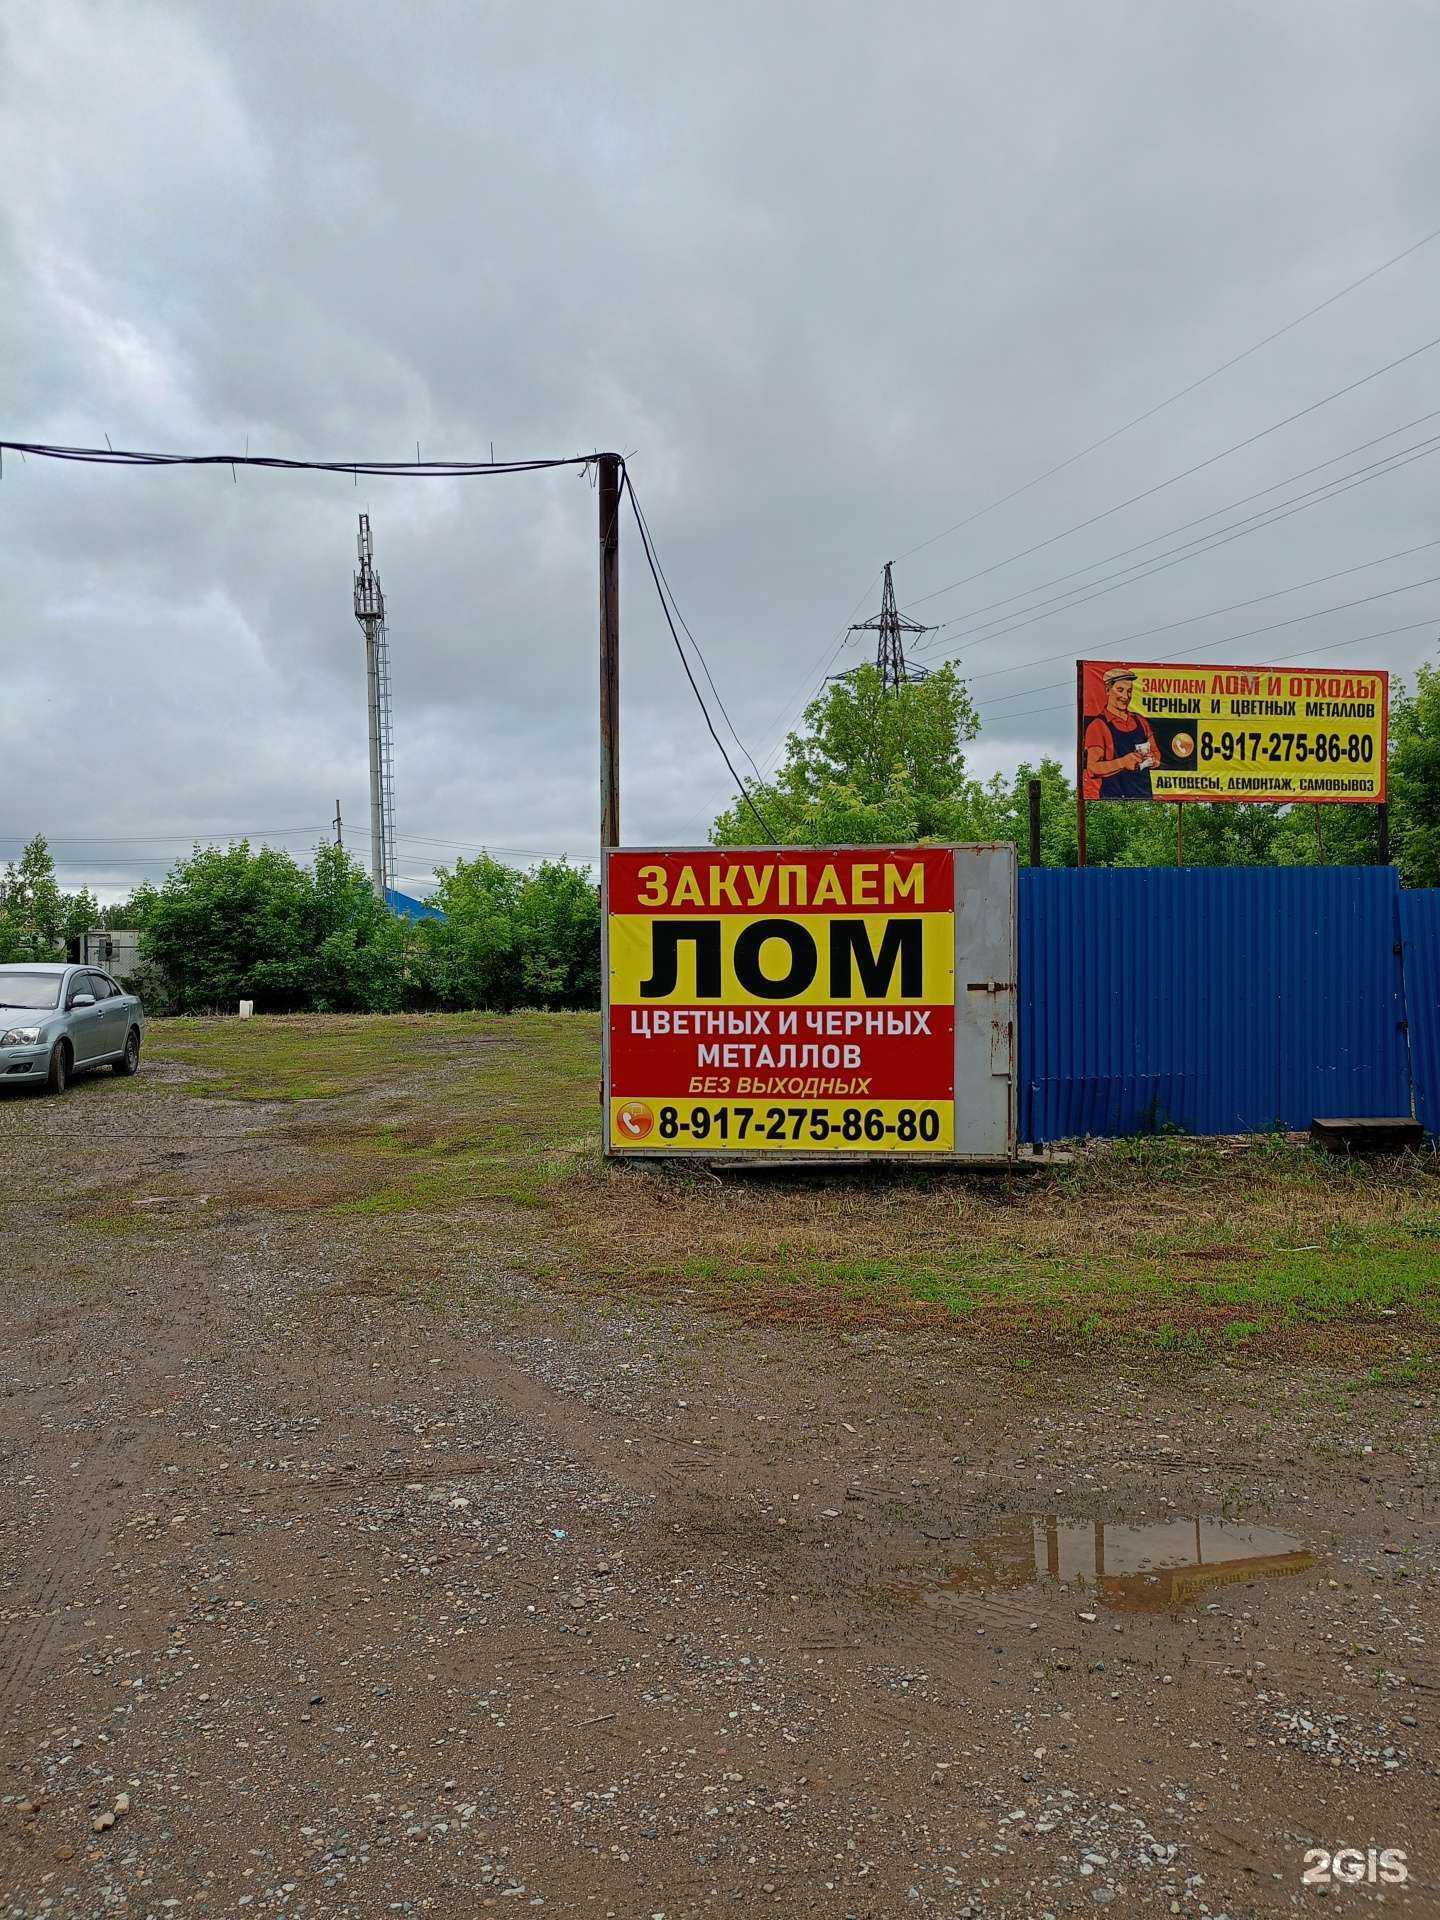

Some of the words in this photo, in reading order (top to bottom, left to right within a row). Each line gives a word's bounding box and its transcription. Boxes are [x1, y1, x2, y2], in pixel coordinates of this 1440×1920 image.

[1142, 678, 1206, 694] ЗАКУПАЕМ
[1211, 674, 1260, 696] ЛОМ
[1267, 676, 1282, 696] И
[1289, 677, 1376, 699] ОТХОДЫ
[1142, 697, 1201, 714] ЧЕРНЫХ
[1211, 699, 1221, 714] И
[1231, 699, 1296, 717] ЦВЕТНЫХ
[1305, 701, 1375, 718] МЕТАЛЛОВ
[1200, 731, 1373, 762] 8-917-275-86-80
[1156, 776, 1224, 792] АВТОВЕСЫ,
[1227, 777, 1296, 793] ДЕМОНТАЖ,
[1300, 777, 1374, 792] САМОВЫВОЗ
[637, 863, 925, 906] ЗАКУПАЕМ
[640, 918, 923, 999] ЛОМ
[630, 1010, 771, 1039] ЦВЕТНЫХ
[778, 1011, 798, 1035] И
[806, 1010, 932, 1035] ЧЕРНЫХ
[697, 1043, 861, 1069] МЕТАЛЛОВ
[688, 1076, 731, 1094] БЕЗ
[736, 1077, 872, 1098] ВЫХОДНЫХ
[659, 1106, 940, 1142] 8-917-275-86-80
